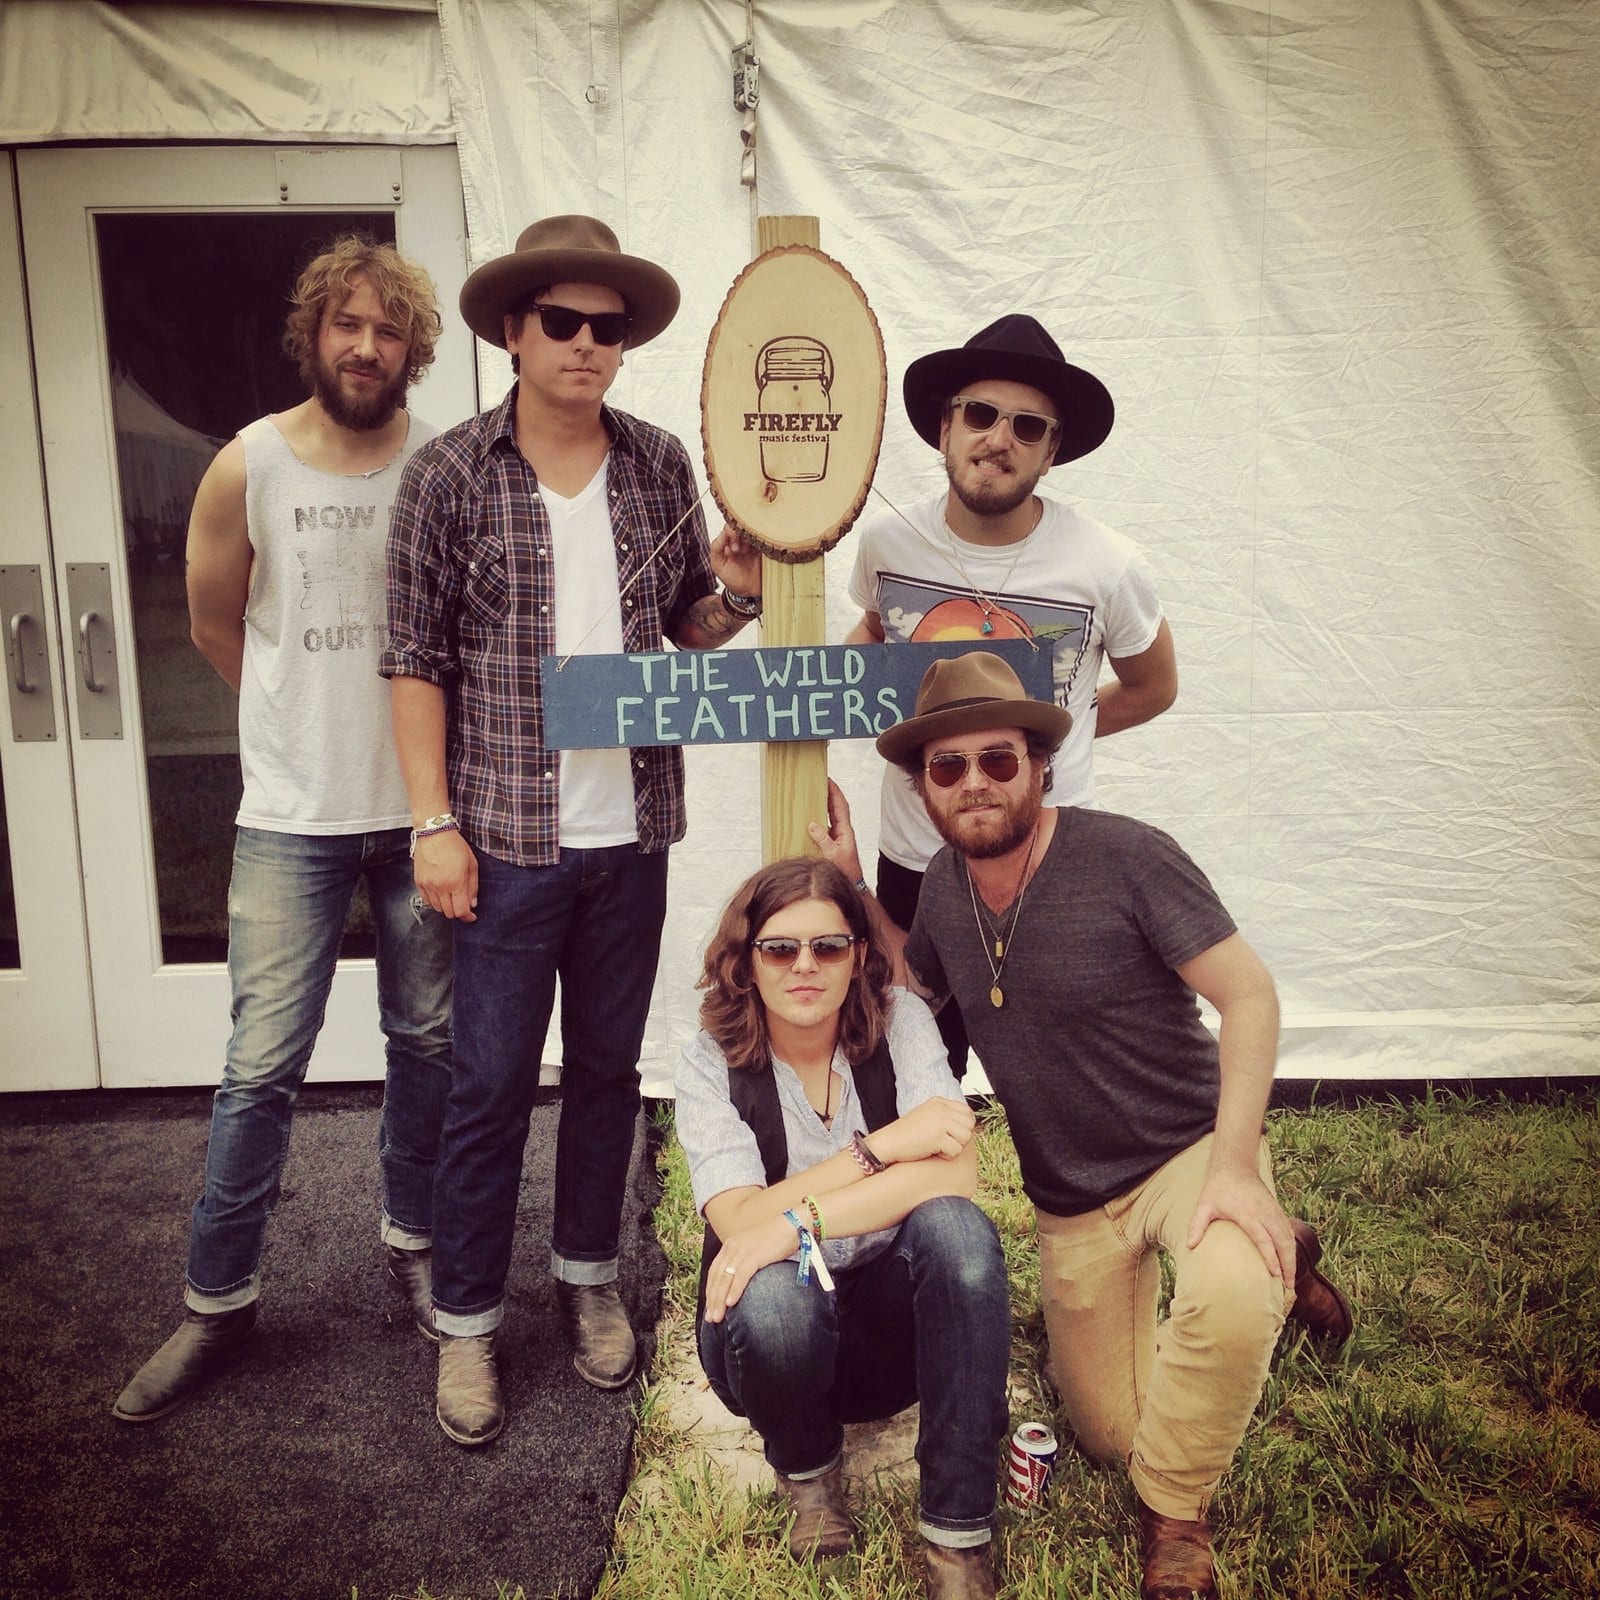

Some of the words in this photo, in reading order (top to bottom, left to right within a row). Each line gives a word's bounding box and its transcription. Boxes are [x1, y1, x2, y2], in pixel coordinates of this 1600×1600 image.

[743, 413, 843, 432] FIREFLY
[759, 433, 790, 443] music
[792, 433, 830, 443] festival
[294, 505, 376, 533] NOW
[304, 624, 366, 653] OUR
[628, 652, 729, 693] THE
[754, 649, 866, 688] WILD
[616, 687, 904, 744] FEATHERS
